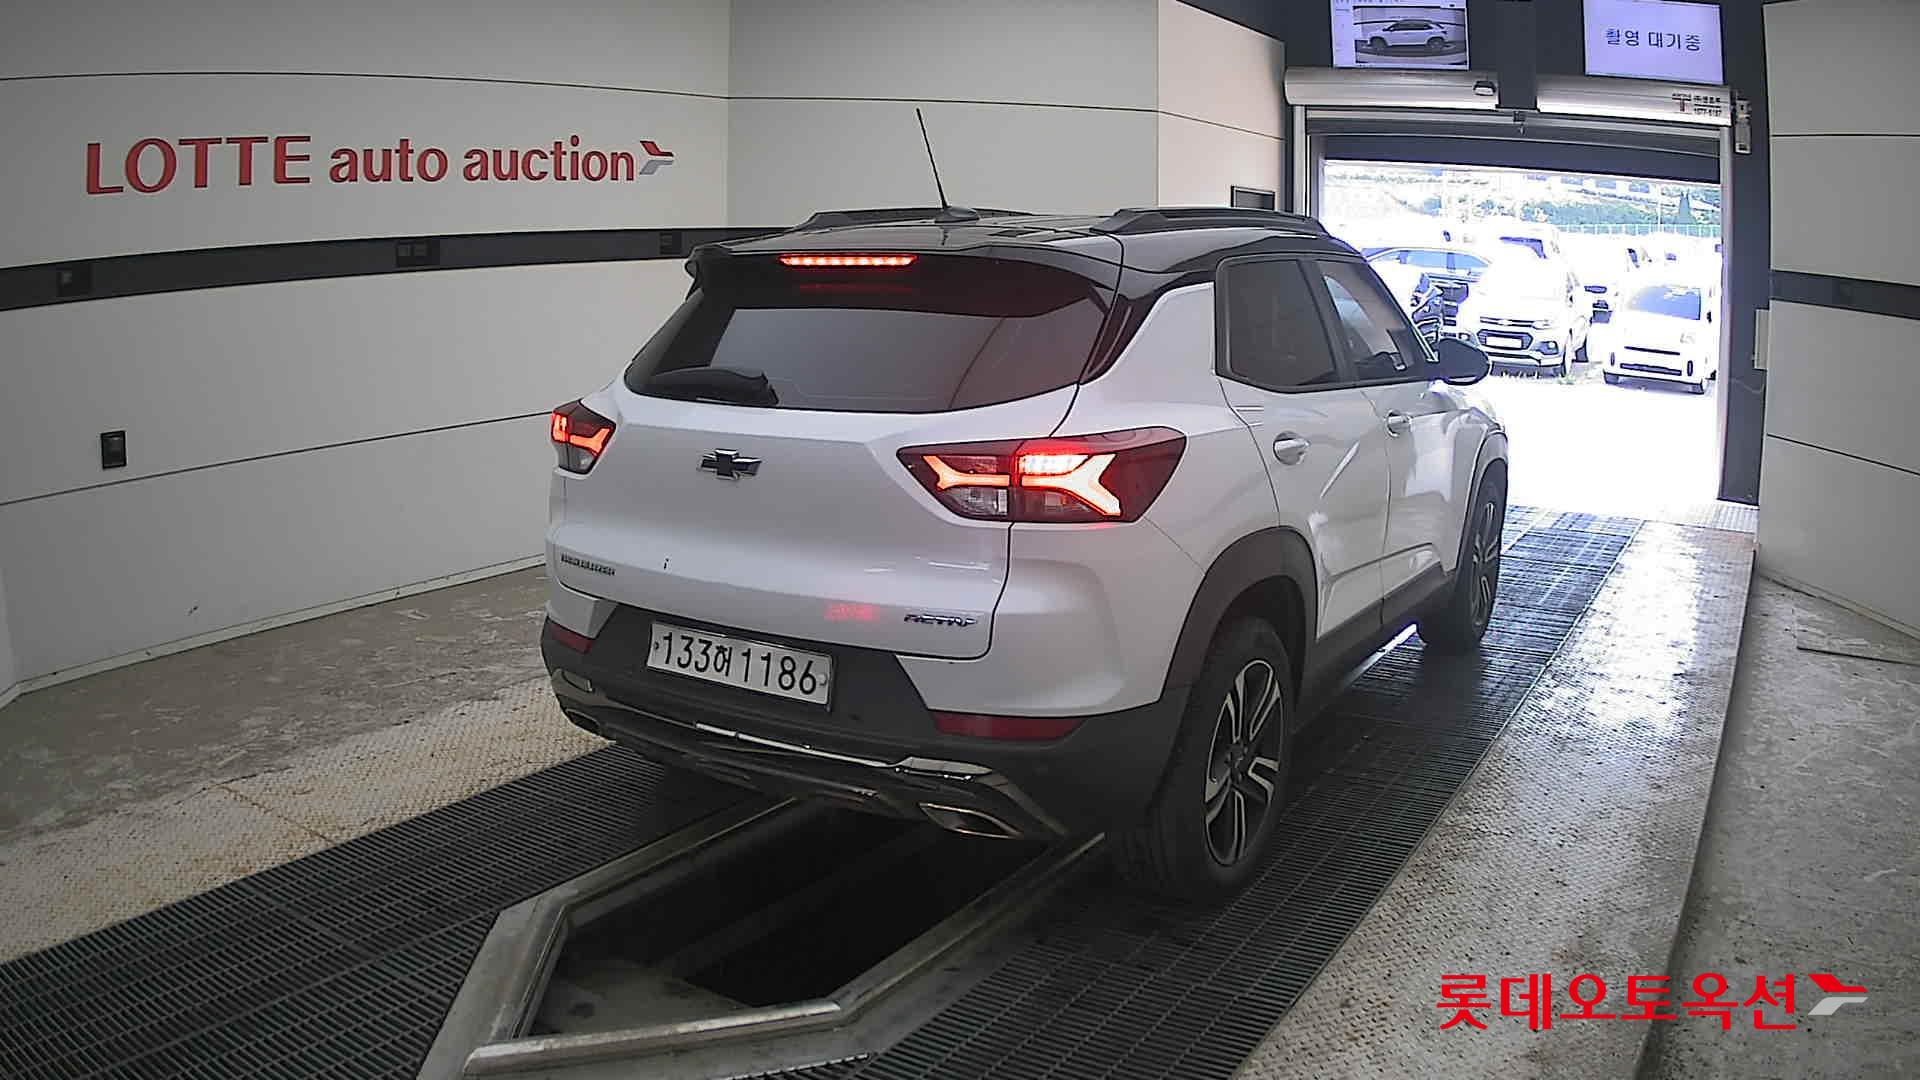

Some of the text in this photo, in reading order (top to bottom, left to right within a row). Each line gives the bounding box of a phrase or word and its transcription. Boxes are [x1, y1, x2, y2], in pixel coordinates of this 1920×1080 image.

[86, 134, 635, 195] LOTTE auto auction
